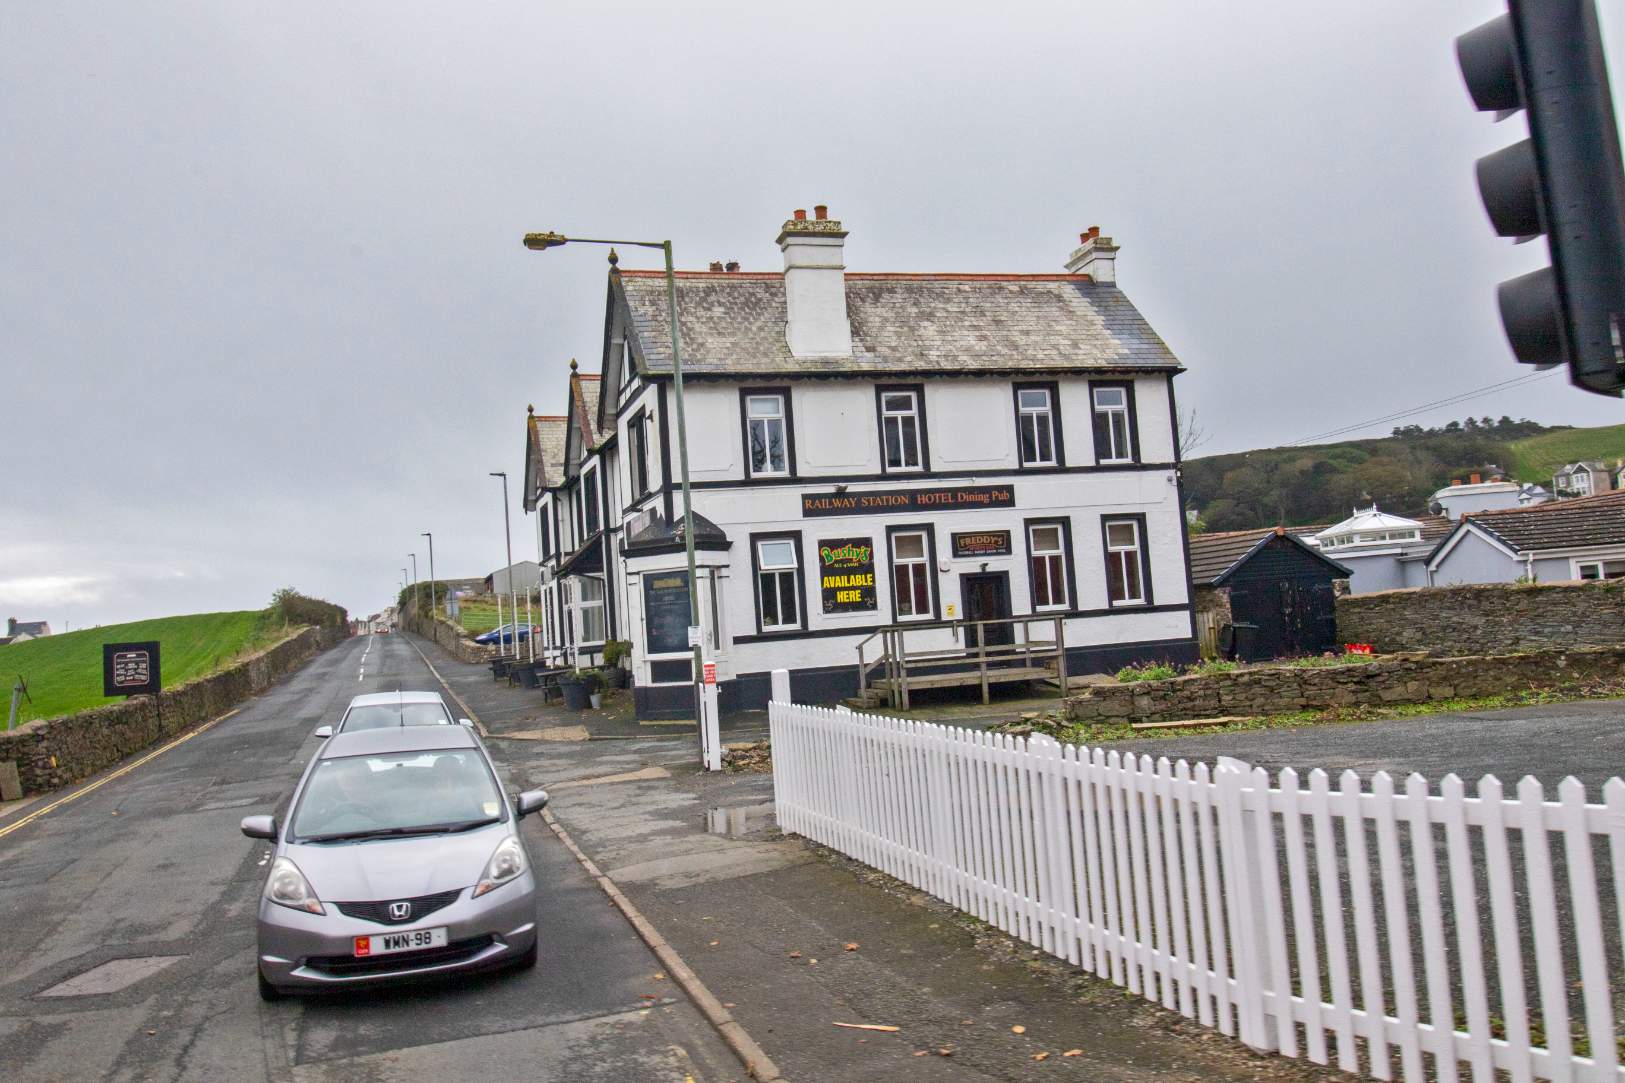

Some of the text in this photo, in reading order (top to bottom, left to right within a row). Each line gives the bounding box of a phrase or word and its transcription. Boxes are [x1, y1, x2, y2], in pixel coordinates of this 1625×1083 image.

[805, 490, 1010, 509] RAILWAY STATION HOTEL Dining Pub
[823, 574, 873, 588] AVAILABLE
[836, 589, 862, 603] HERE
[384, 931, 431, 950] WMN-98
